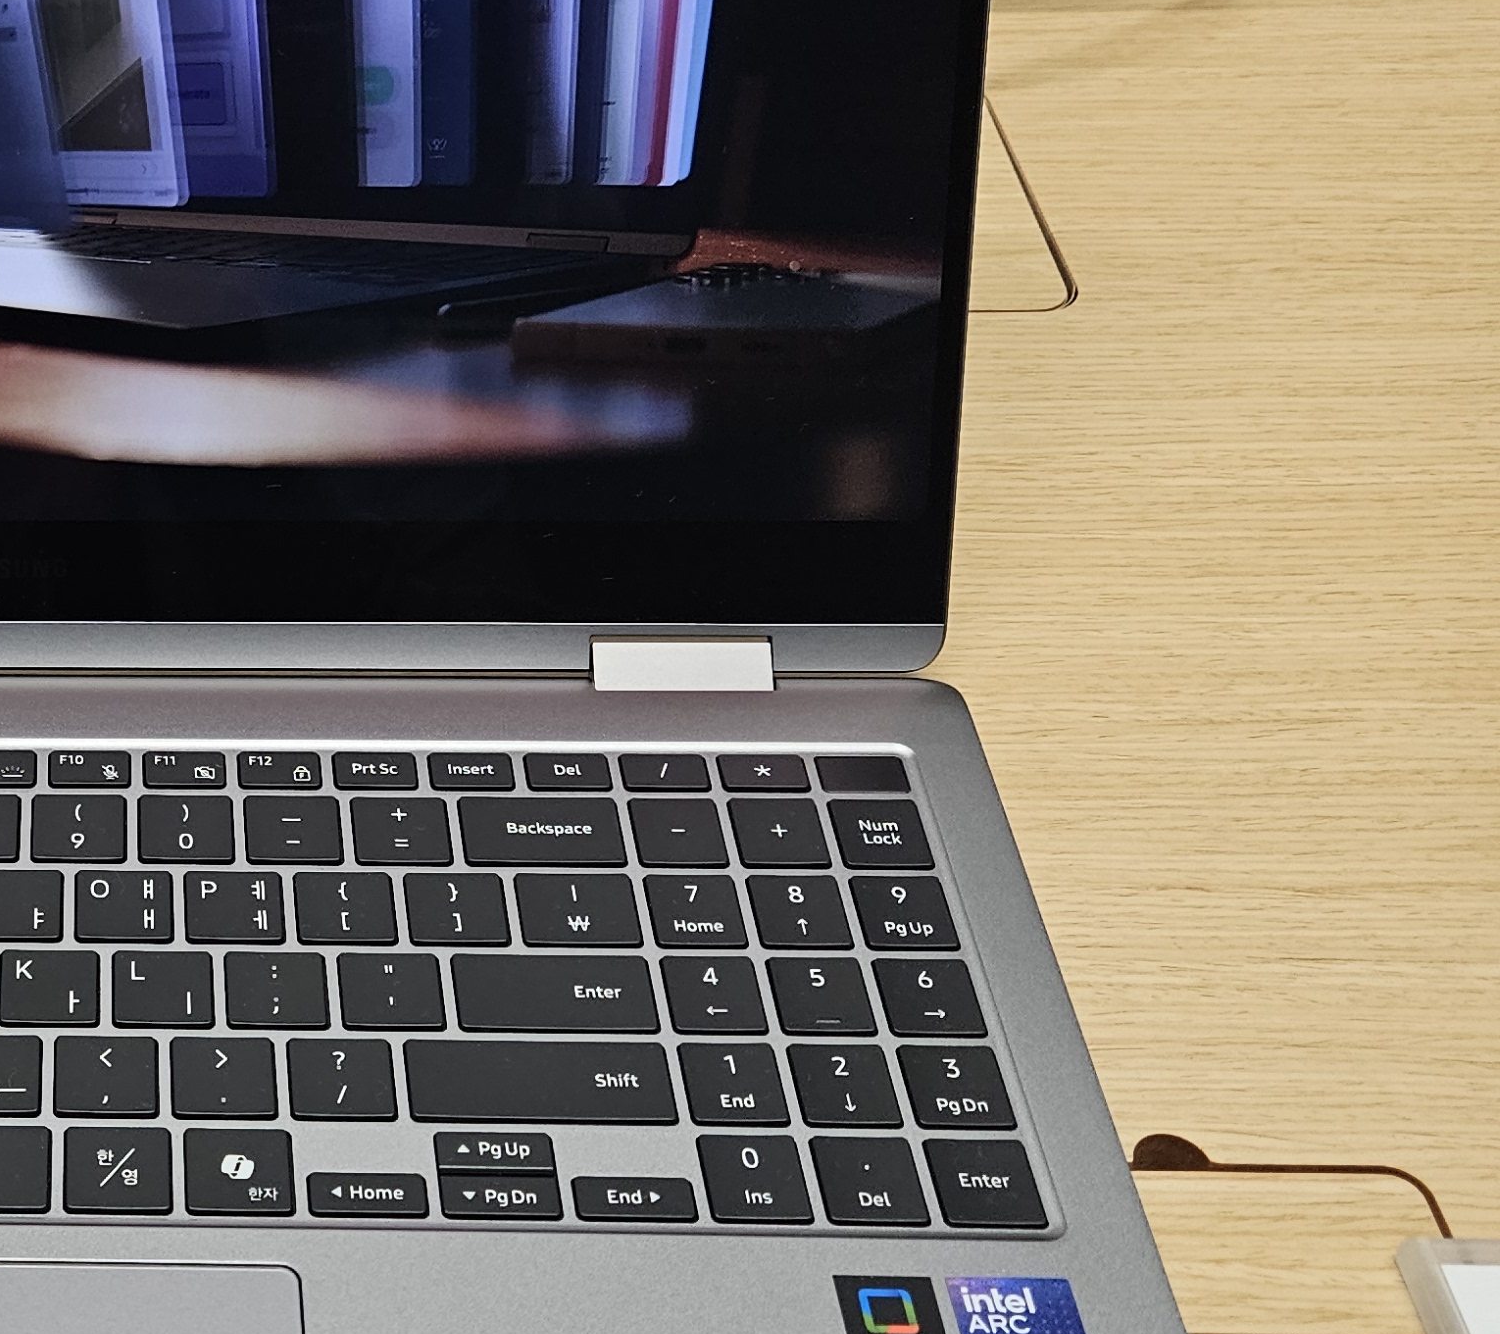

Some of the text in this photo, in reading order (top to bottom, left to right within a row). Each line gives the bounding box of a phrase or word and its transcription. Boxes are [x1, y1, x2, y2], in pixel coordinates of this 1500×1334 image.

[59, 754, 84, 765] F10
[154, 754, 176, 766] F11
[248, 755, 273, 766] F12
[351, 762, 399, 775] Prt Sc
[447, 763, 495, 775] Insert
[553, 763, 582, 776] Del
[506, 821, 593, 837] Backspace
[858, 819, 898, 831] Num
[70, 832, 85, 849] 9
[178, 833, 194, 850] 0
[862, 833, 902, 845] Lock
[90, 879, 110, 899] O
[200, 880, 218, 899] P
[683, 884, 698, 903] 7
[787, 885, 805, 903] 8
[890, 886, 907, 904] 9
[673, 919, 724, 933] Home
[15, 959, 33, 980] K
[130, 960, 146, 981] L
[702, 966, 719, 986] 4
[809, 968, 825, 987] 5
[917, 970, 934, 989] 6
[573, 985, 622, 999] Enter
[723, 1054, 736, 1075] 1
[830, 1055, 850, 1077] 2
[941, 1058, 961, 1079] 3
[594, 1072, 640, 1088] Shift
[719, 1093, 756, 1108] End
[741, 1147, 759, 1169] 0
[958, 1172, 1010, 1189] Enter
[248, 1186, 279, 1202] 한자
[349, 1184, 405, 1200] Home
[606, 1189, 643, 1205] End
[744, 1189, 774, 1205] Ins
[858, 1191, 892, 1207] Del
[961, 1287, 1035, 1314] intel
[969, 1314, 1030, 1334] ARC
